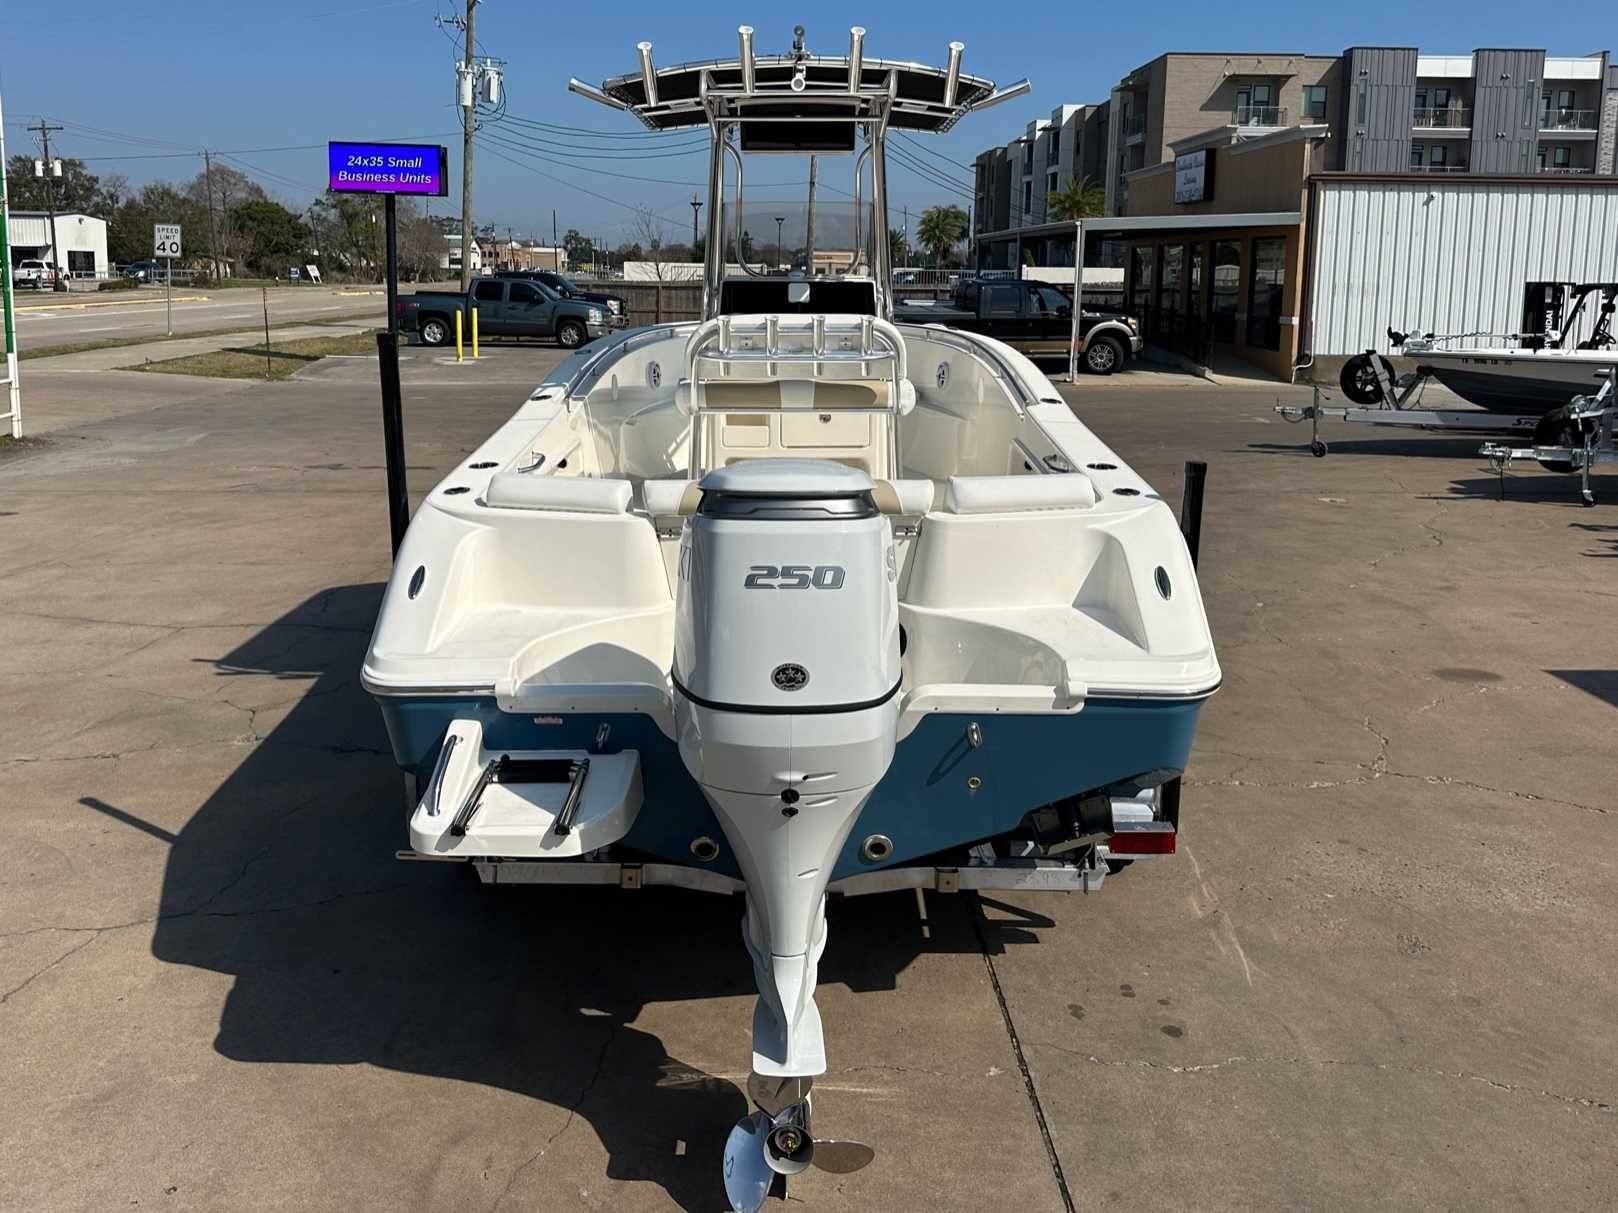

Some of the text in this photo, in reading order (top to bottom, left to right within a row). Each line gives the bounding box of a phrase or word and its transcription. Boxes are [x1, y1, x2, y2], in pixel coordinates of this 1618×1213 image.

[347, 155, 422, 169] 24x35 Small
[338, 170, 432, 184] Business Units
[156, 241, 179, 254] 40
[1544, 310, 1554, 350] HYNDAI
[743, 565, 846, 590] 250
